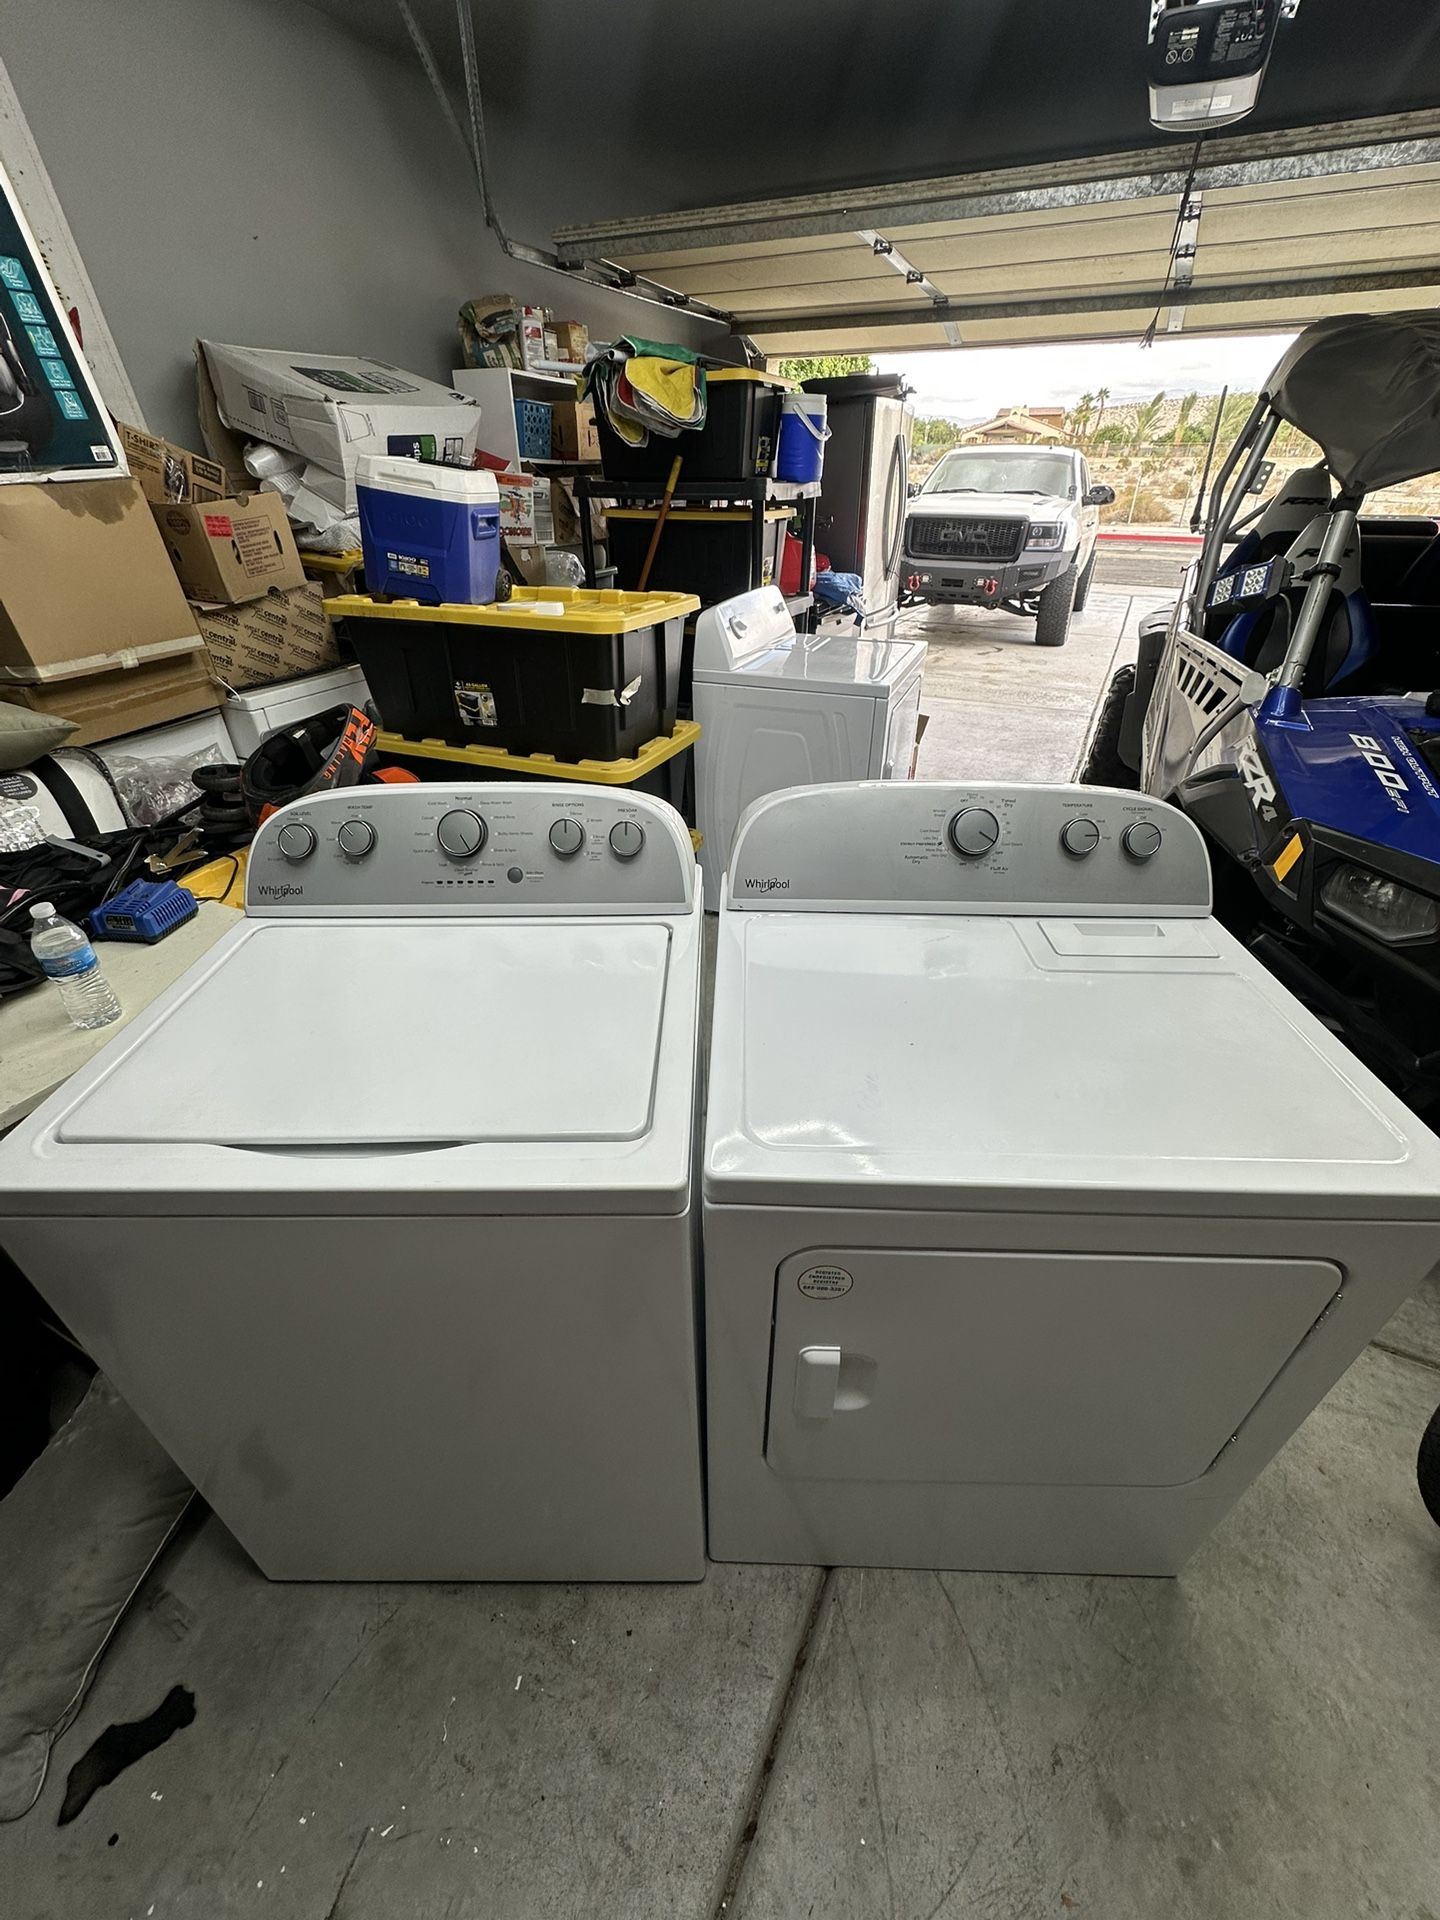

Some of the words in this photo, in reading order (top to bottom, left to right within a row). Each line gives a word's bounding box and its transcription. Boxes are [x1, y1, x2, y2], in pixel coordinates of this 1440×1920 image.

[941, 530, 988, 542] GMC
[263, 609, 288, 626] central
[208, 630, 238, 647] central
[260, 629, 286, 646] central
[256, 649, 281, 664] central
[1349, 733, 1409, 792] 800
[1391, 735, 1412, 757] HIGH
[1406, 757, 1440, 799] OUTPUT
[1232, 734, 1277, 812] RZR
[1261, 804, 1278, 822] 4
[258, 885, 304, 898] Whirlpool
[745, 878, 790, 893] Whirlpool
